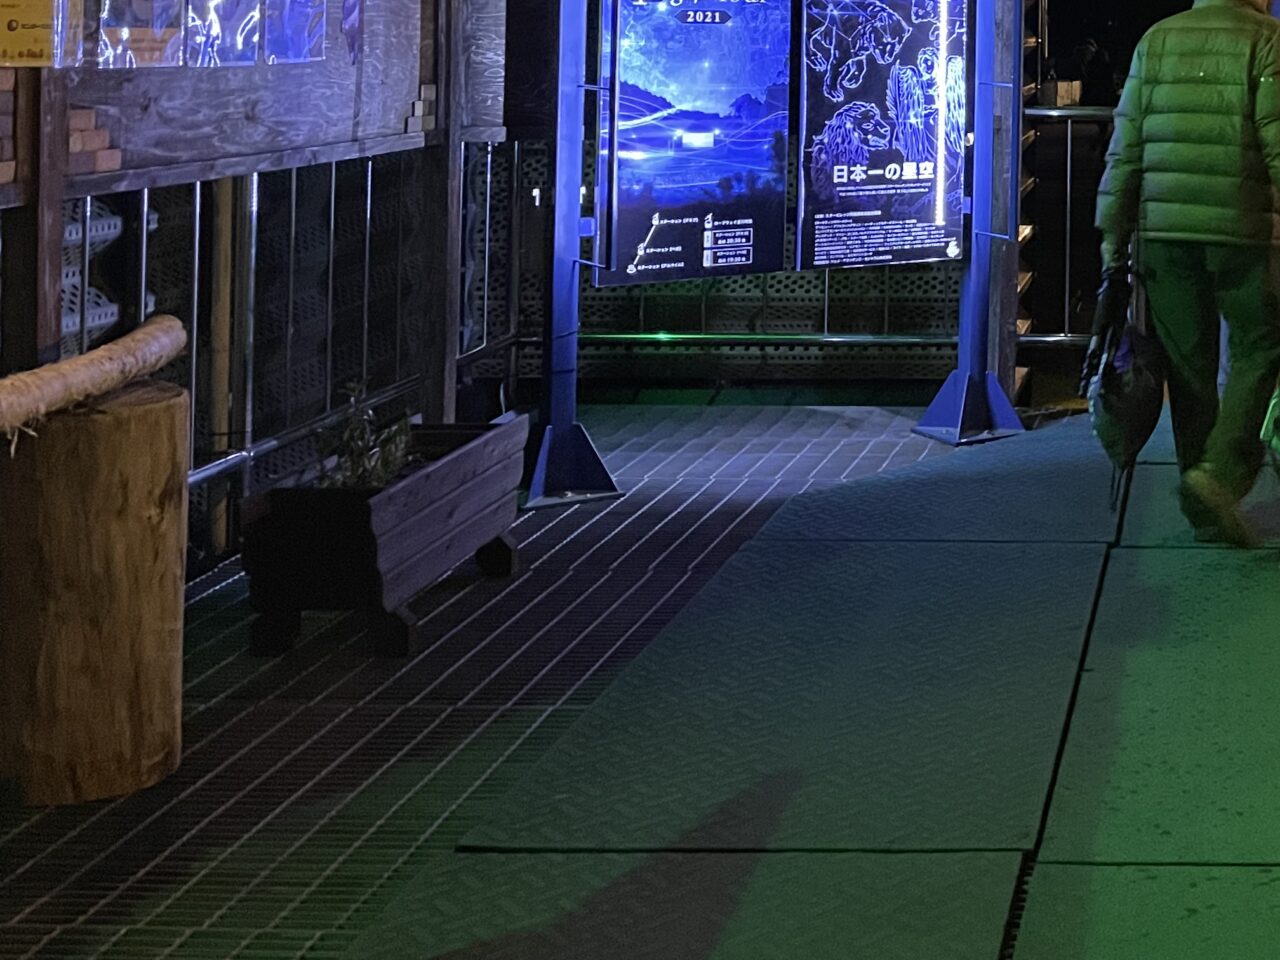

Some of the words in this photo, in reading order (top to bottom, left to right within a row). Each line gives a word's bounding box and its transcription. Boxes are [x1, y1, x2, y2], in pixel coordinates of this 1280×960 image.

[686, 11, 721, 23] 2021
[833, 161, 935, 184] 日本一の星空
